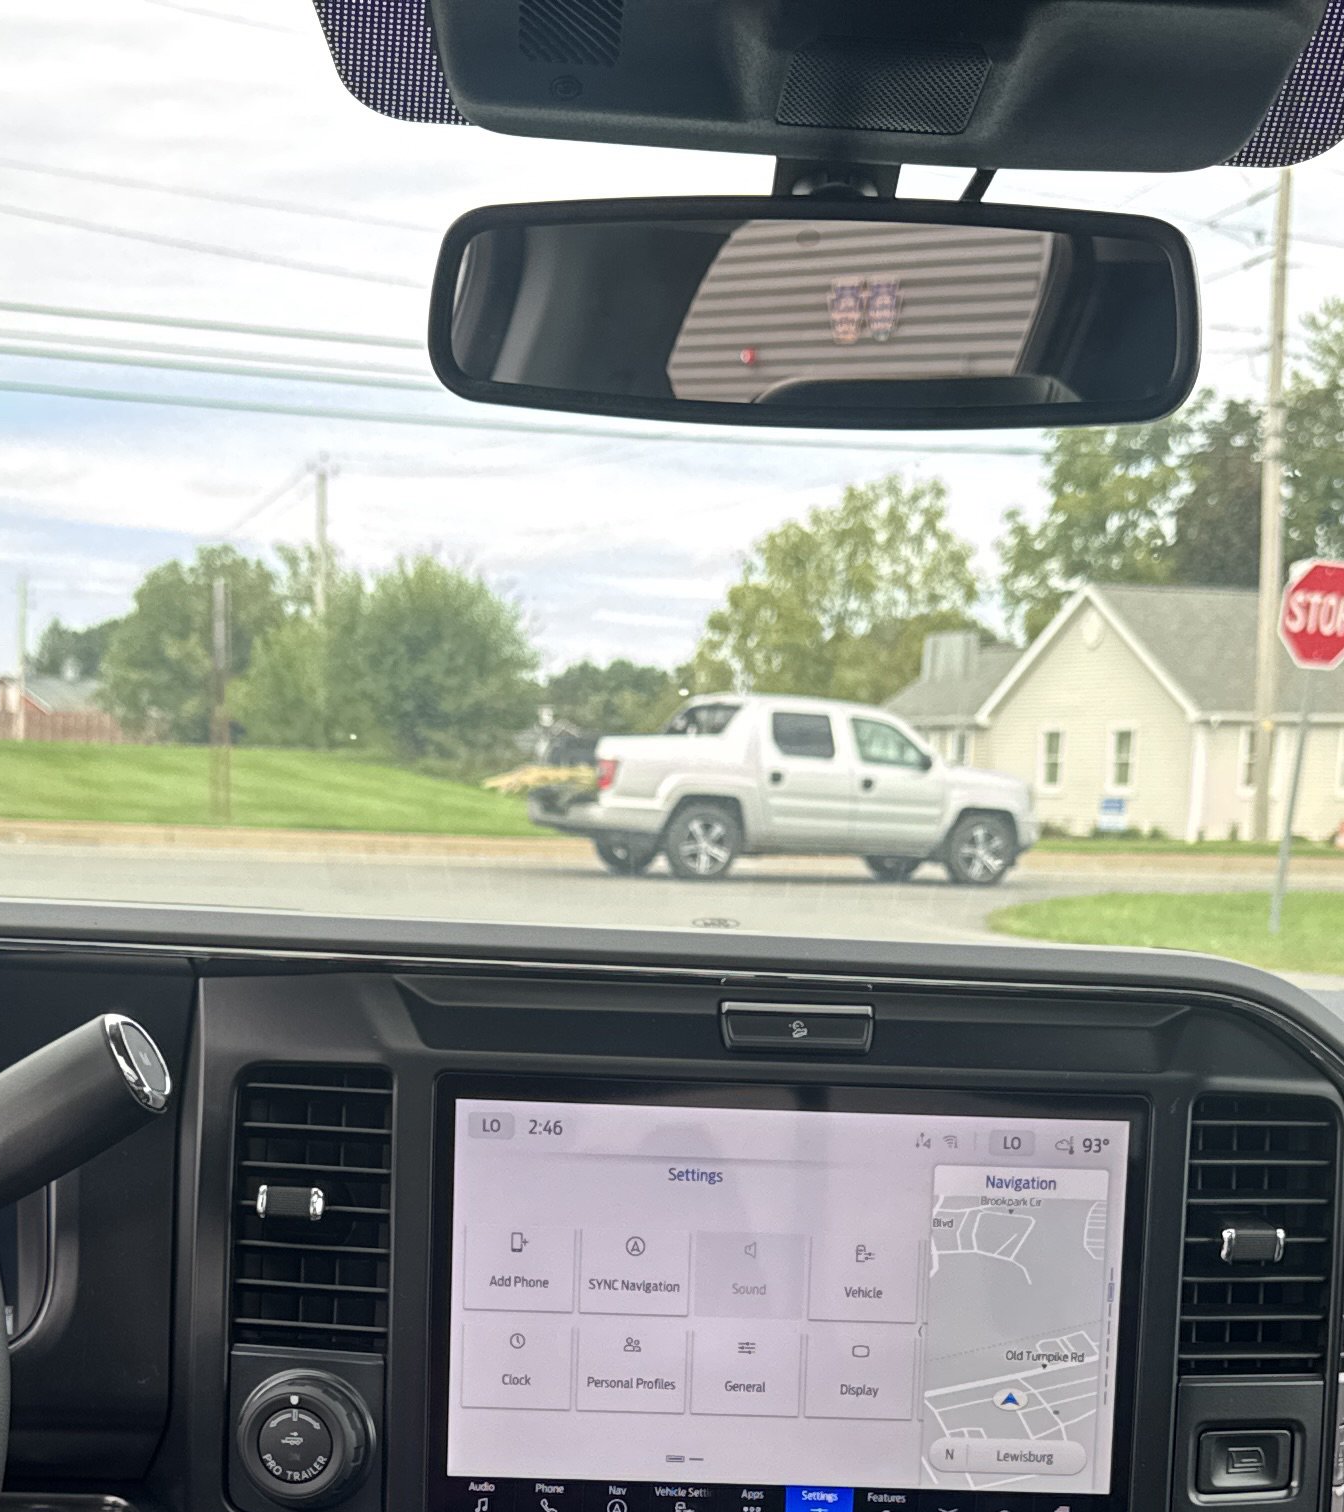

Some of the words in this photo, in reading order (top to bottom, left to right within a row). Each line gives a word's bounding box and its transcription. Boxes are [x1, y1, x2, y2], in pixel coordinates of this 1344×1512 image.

[481, 1118, 501, 1134] LO
[528, 1120, 563, 1137] 2:46
[1003, 1135, 1022, 1151] LO
[1082, 1138, 1110, 1154] 93°
[668, 1167, 723, 1184] Settings
[985, 1174, 1057, 1192] Navigation
[932, 1218, 953, 1228] Blvd
[489, 1275, 511, 1289] Add
[514, 1276, 549, 1290] Phone
[588, 1279, 616, 1292] SYNC
[618, 1279, 680, 1295] Navigation
[732, 1282, 767, 1296] Sound
[844, 1286, 882, 1300] Vehicle
[1006, 1350, 1024, 1362] Old
[1026, 1350, 1068, 1365] Turnpike
[1070, 1351, 1084, 1363] Rd
[501, 1373, 531, 1386] Clock
[587, 1376, 632, 1391] Personal
[636, 1377, 676, 1391] Profiles
[724, 1380, 765, 1393] General
[840, 1383, 879, 1399] Display
[945, 1449, 955, 1460] N
[996, 1449, 1053, 1466] Lewisburg
[262, 1453, 282, 1475] PRO
[286, 1455, 328, 1481] TRAILER
[468, 1481, 495, 1492] Audio
[535, 1483, 564, 1494] Phone
[609, 1486, 626, 1495] Nav
[655, 1487, 687, 1497] Vehicle
[741, 1489, 764, 1500] Apps
[802, 1491, 839, 1503] Settings
[867, 1492, 906, 1503] Features
